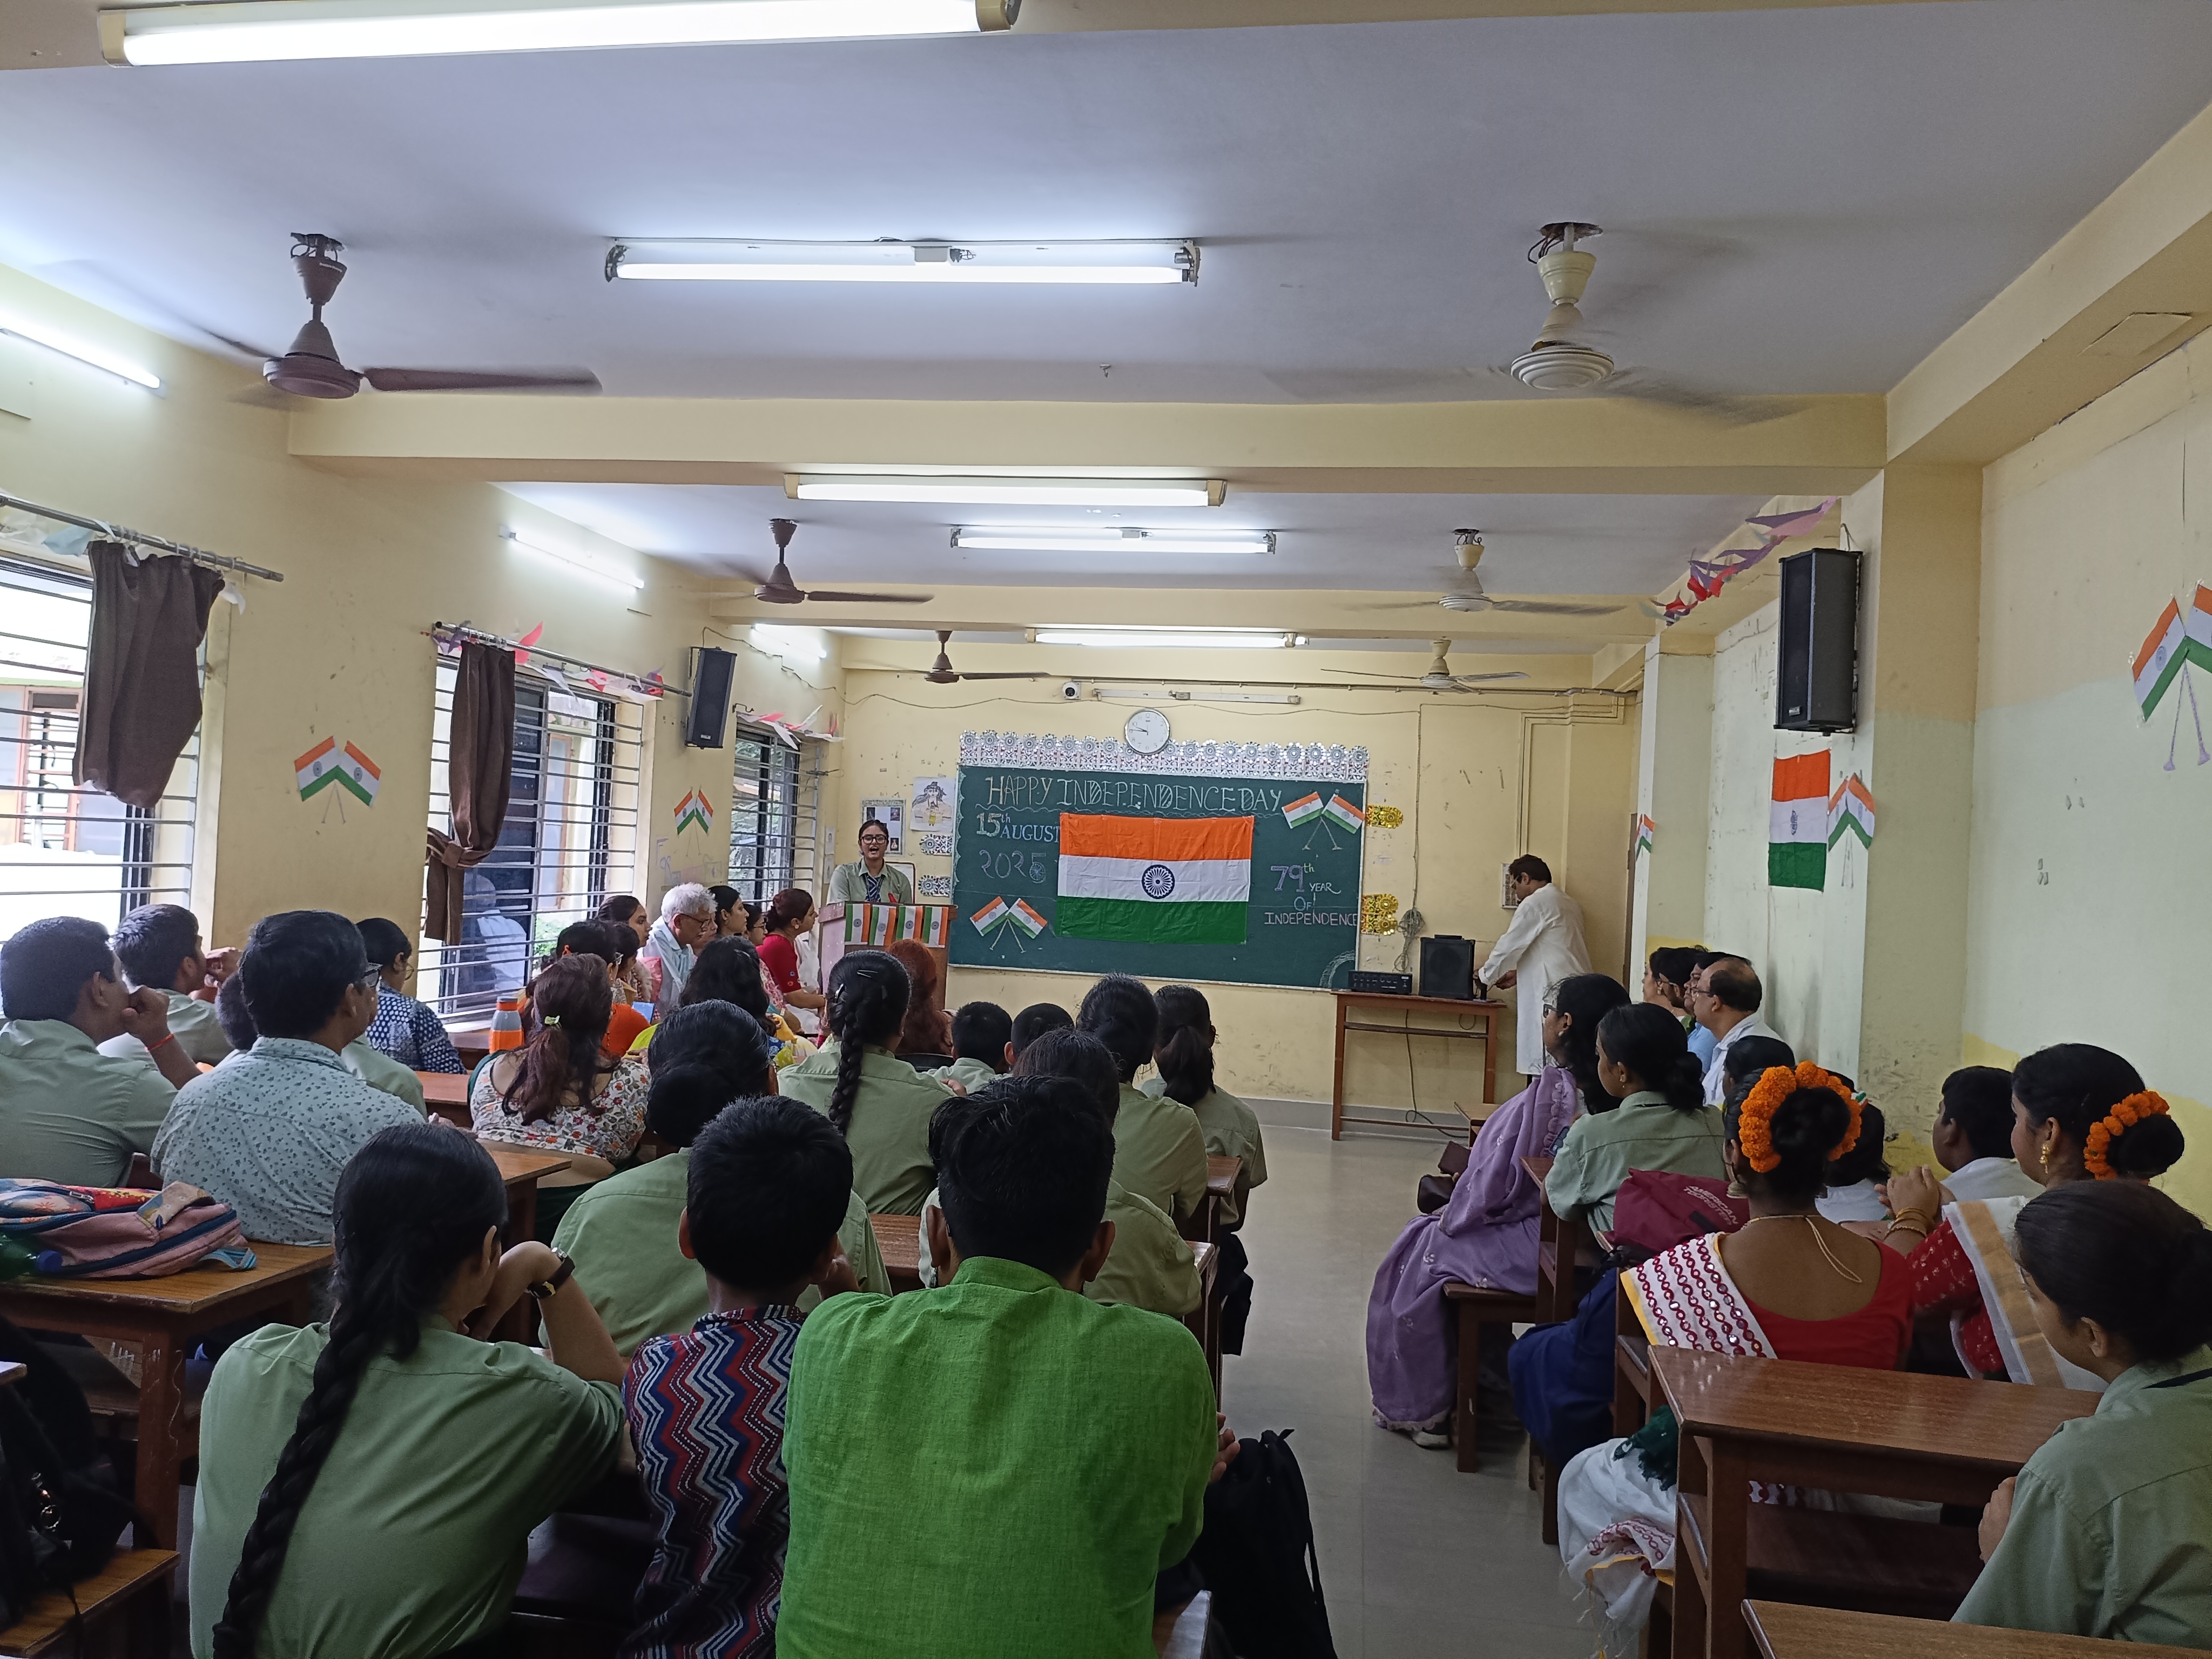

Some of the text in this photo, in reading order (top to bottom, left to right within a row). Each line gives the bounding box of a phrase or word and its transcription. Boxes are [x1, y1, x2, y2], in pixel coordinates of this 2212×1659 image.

[985, 775, 1282, 812] HAPPY INDEPENDENCE DAY
[1000, 824, 1060, 843] AUGUST
[979, 849, 1047, 884] 2025
[1309, 882, 1341, 894] YEAR
[1264, 912, 1358, 926] INDEPENDENCE
[1683, 1186, 1732, 1225] TOURISTER
[1688, 1185, 1738, 1224] AMERICAN
